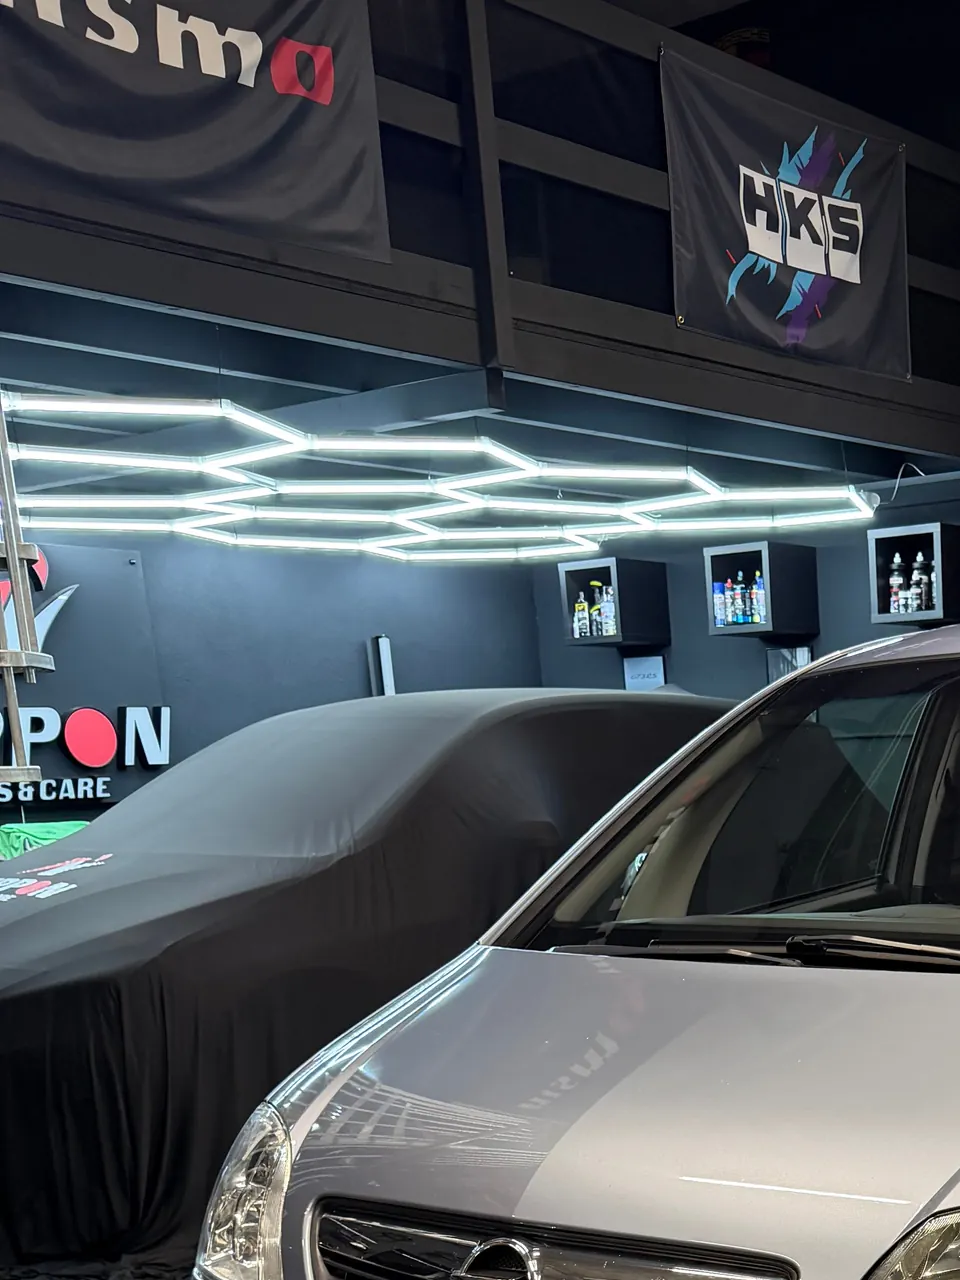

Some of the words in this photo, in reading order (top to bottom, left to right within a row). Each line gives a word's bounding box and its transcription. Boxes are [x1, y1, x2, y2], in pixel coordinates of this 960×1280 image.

[742, 172, 860, 256] HKS
[0, 706, 171, 768] PON
[39, 776, 112, 801] CARE
